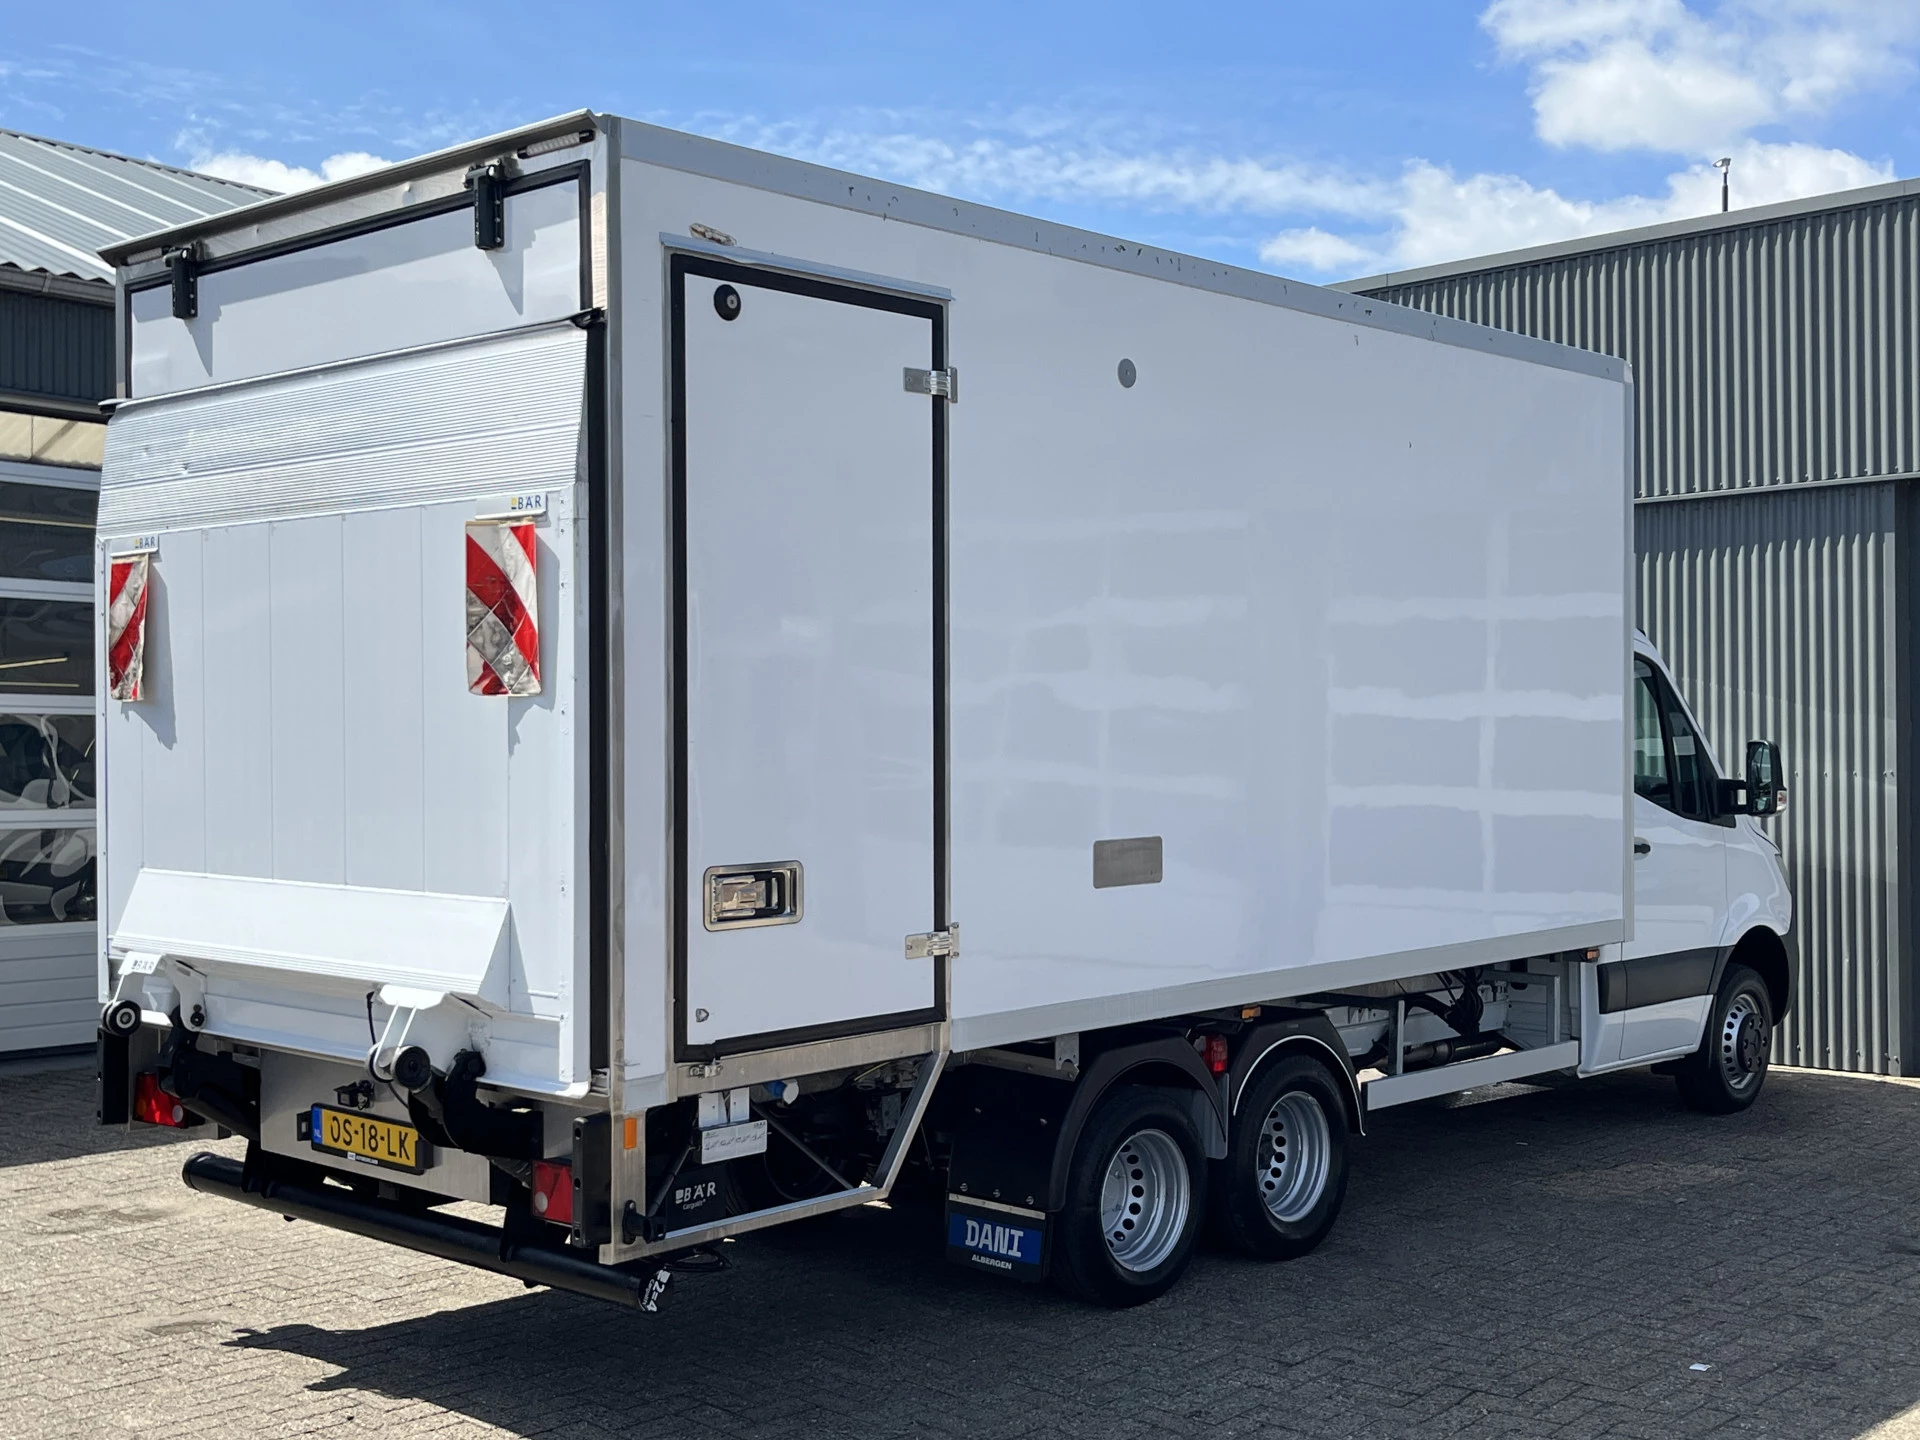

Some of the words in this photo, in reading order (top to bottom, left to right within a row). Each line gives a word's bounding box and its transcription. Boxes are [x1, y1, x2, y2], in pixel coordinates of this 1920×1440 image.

[518, 495, 542, 509] BÄR
[140, 536, 155, 548] BÄR
[331, 1116, 410, 1160] OS-18-LK
[684, 1182, 717, 1202] BÄR
[965, 1220, 1024, 1258] DANI
[971, 1254, 1012, 1270] ALBERGEN
